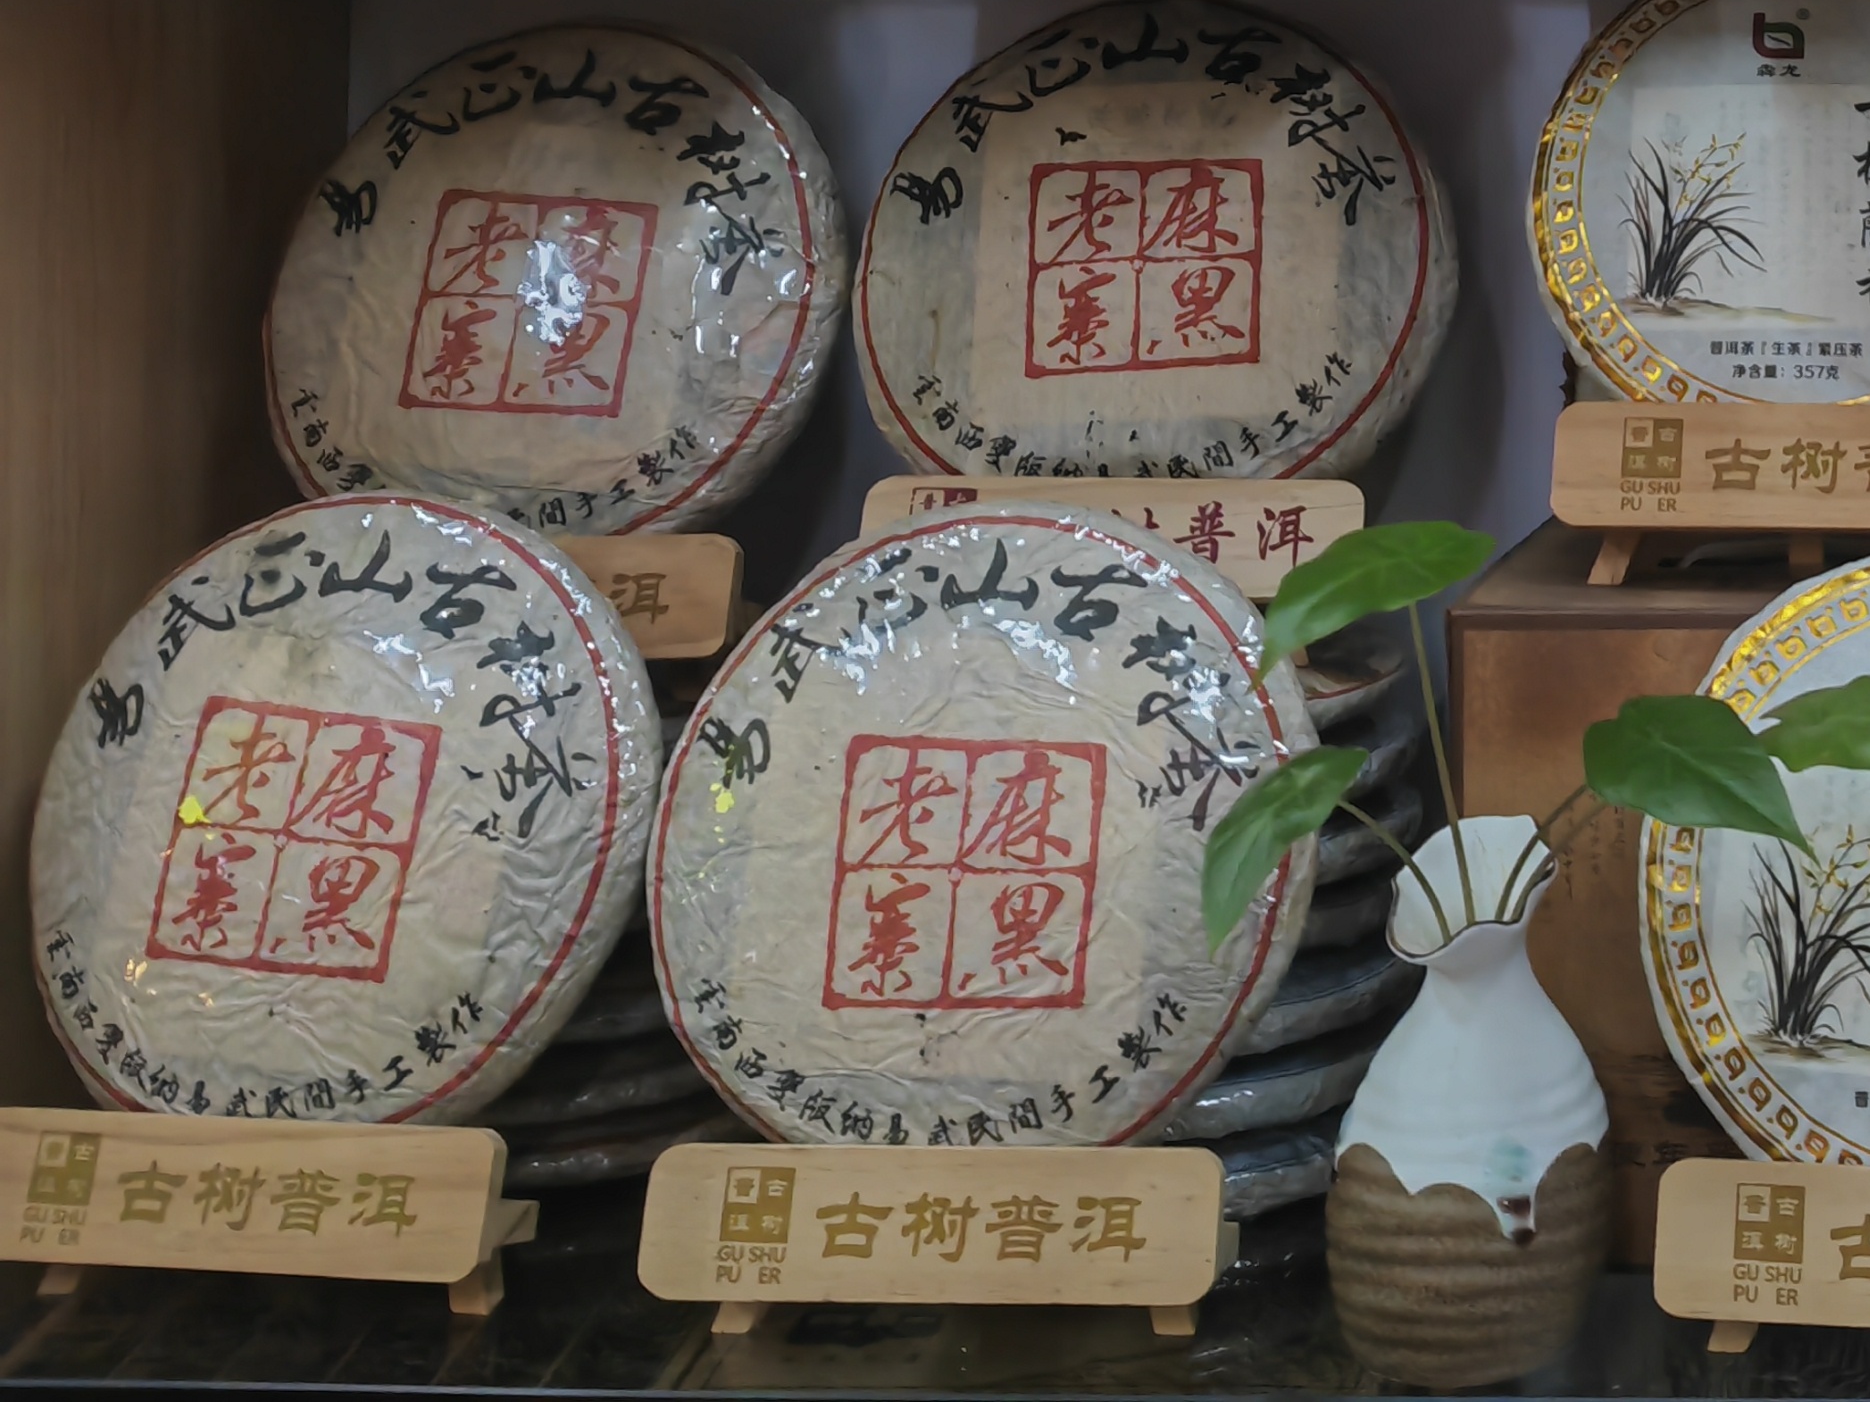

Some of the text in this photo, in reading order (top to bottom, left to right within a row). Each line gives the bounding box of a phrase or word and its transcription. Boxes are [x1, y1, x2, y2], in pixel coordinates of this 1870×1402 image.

[1620, 481, 1680, 496] GU SHU
[1620, 497, 1677, 512] PU ER
[118, 1160, 417, 1238] 古树普洱
[816, 1192, 1146, 1262] 古树普洱
[717, 1246, 786, 1263] GU SHU
[717, 1267, 782, 1284] PU ER
[1733, 1264, 1802, 1280] GU SHU
[1733, 1288, 1799, 1304] PU ER
